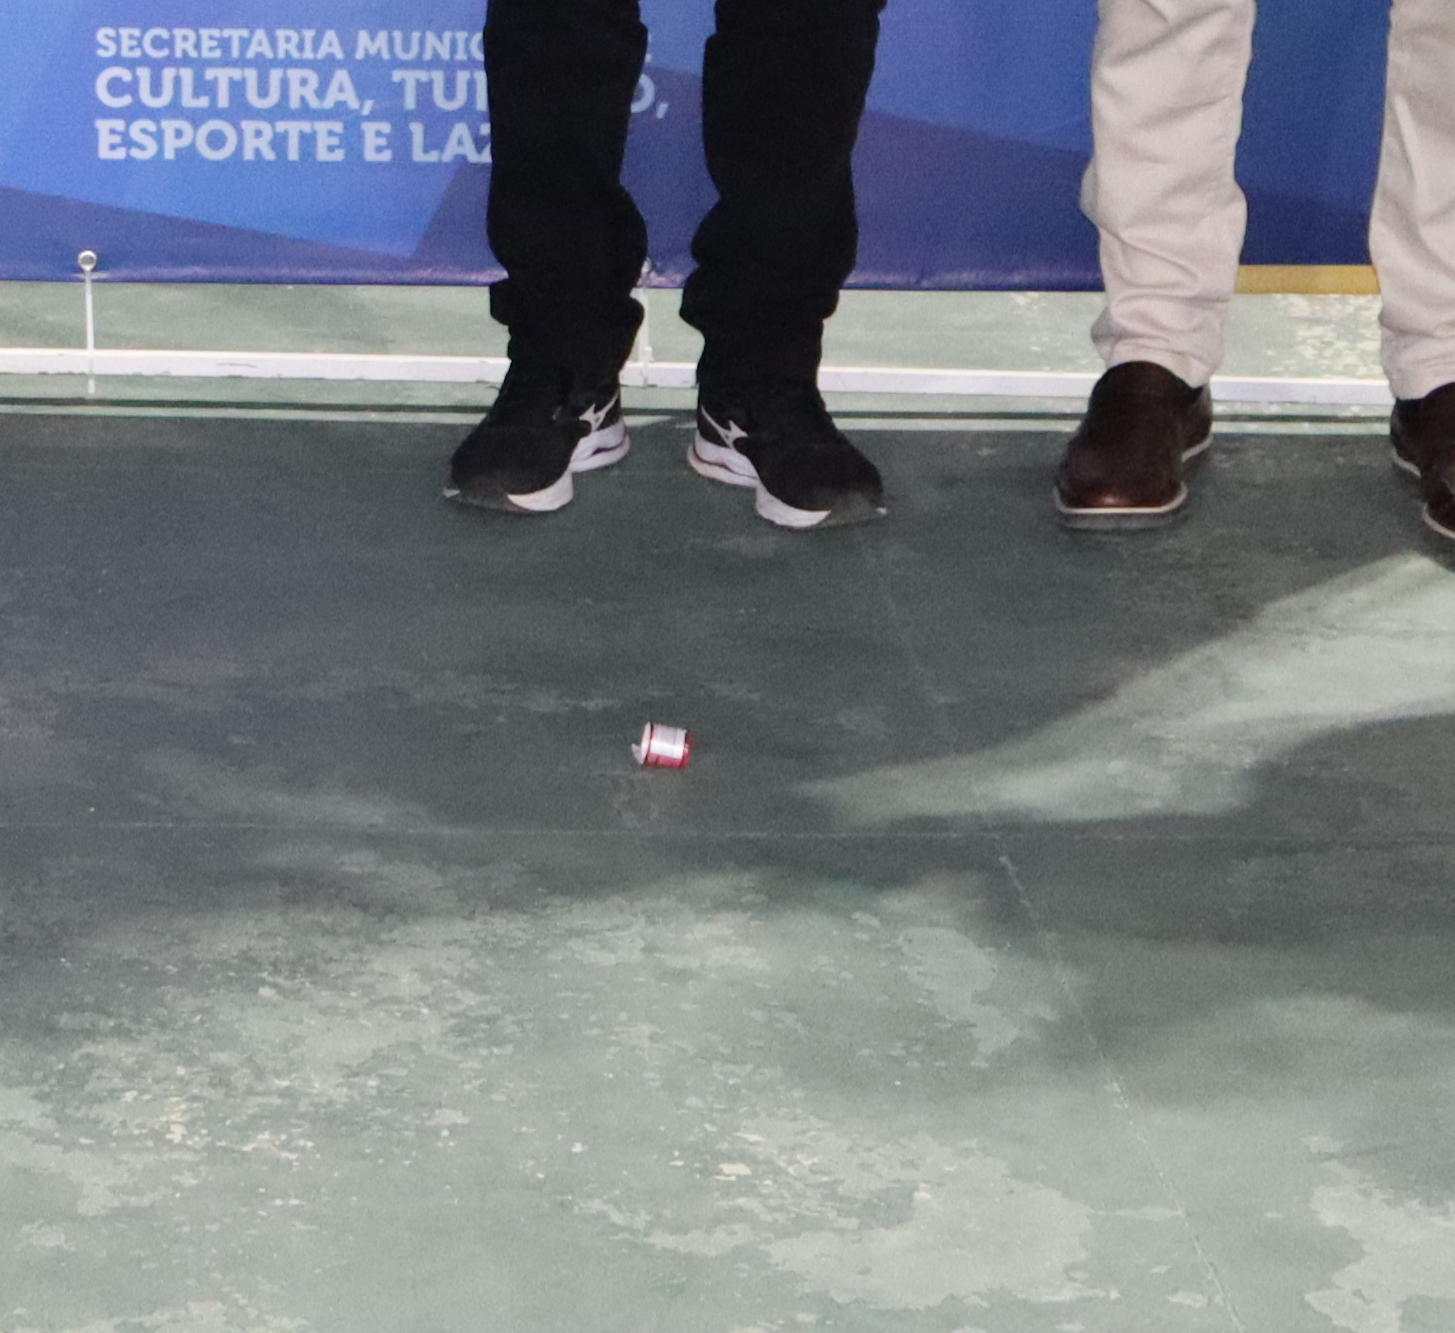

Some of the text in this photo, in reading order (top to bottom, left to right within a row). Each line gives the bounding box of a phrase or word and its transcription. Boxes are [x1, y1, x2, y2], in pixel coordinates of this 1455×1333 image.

[95, 27, 345, 60] SECRETARIA
[95, 66, 376, 116] CULTURA,
[95, 118, 346, 162] ESPORTE
[360, 121, 392, 163] E
